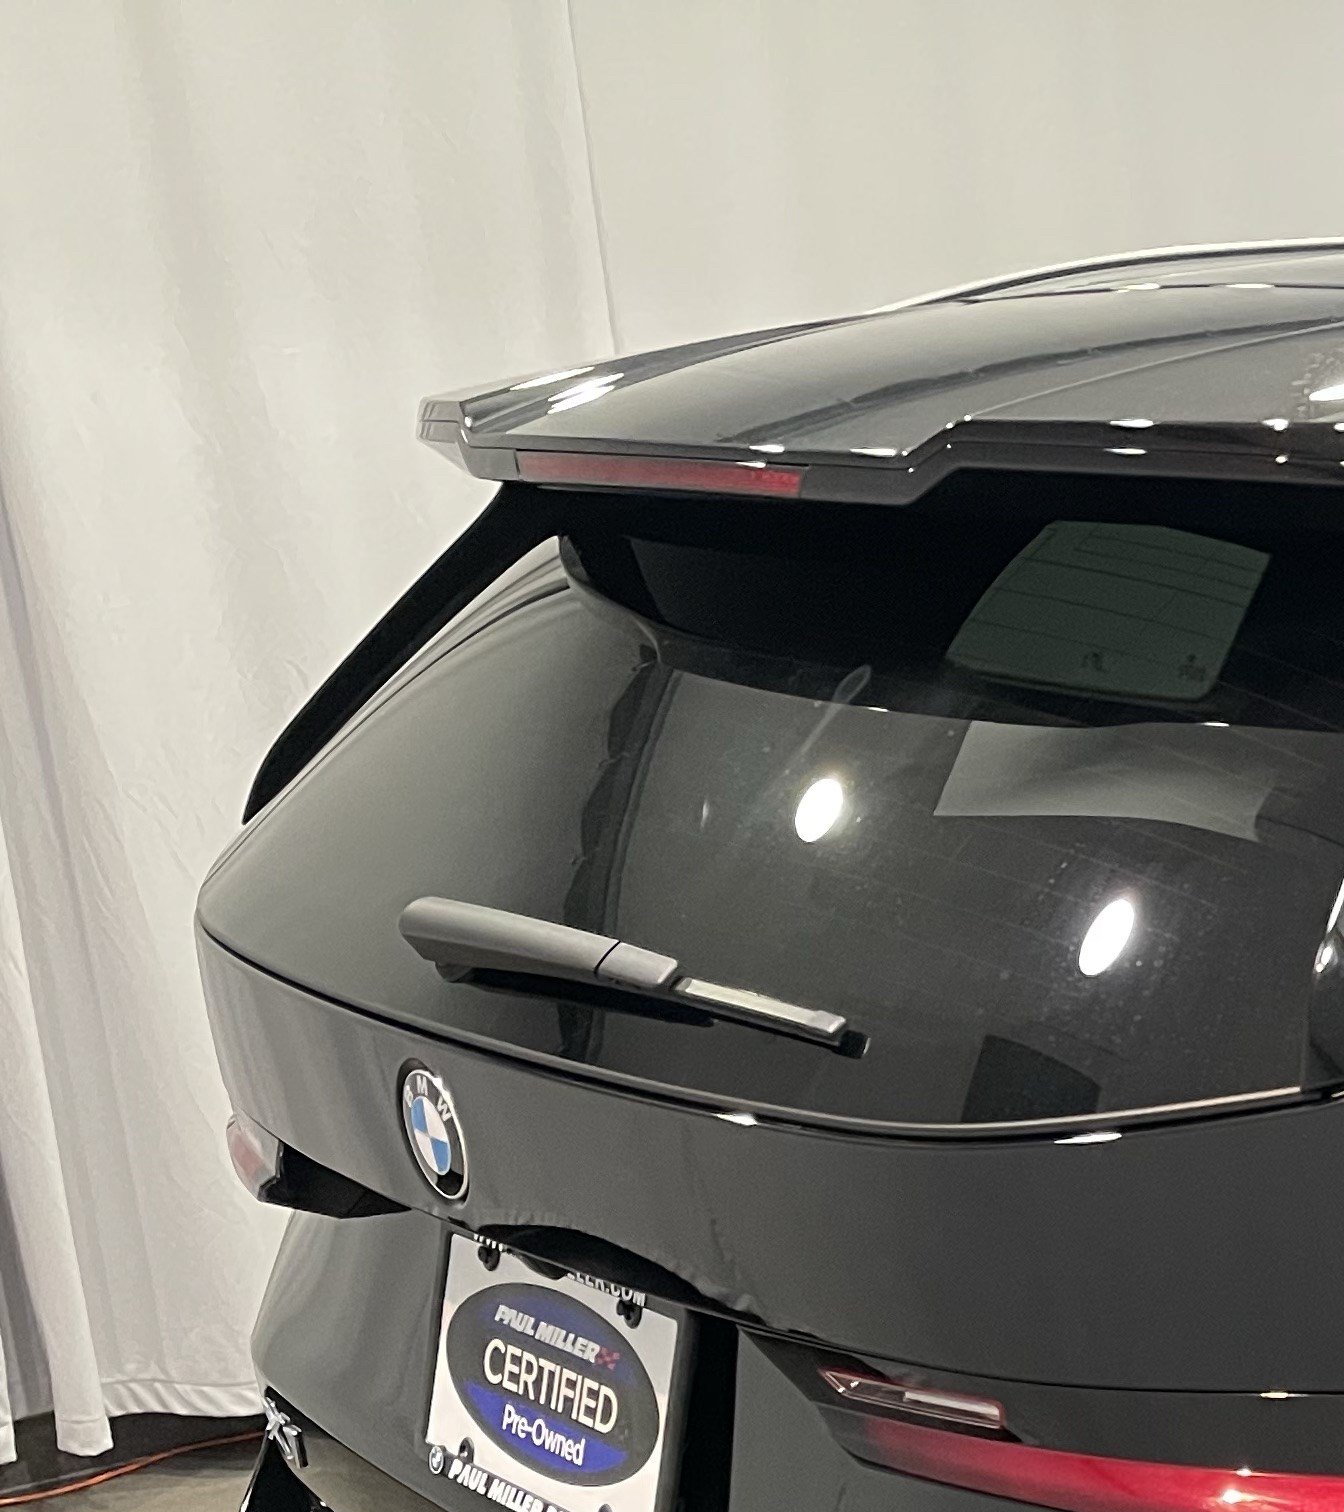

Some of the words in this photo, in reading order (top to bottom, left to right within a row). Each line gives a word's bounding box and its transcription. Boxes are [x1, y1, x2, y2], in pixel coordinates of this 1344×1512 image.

[404, 1074, 452, 1122] BMW
[494, 1305, 535, 1335] PAUL
[534, 1321, 600, 1364] MILLER
[483, 1338, 618, 1434] CERTIFIED
[502, 1404, 586, 1466] Pre-Owned
[448, 1458, 488, 1496] PAUL
